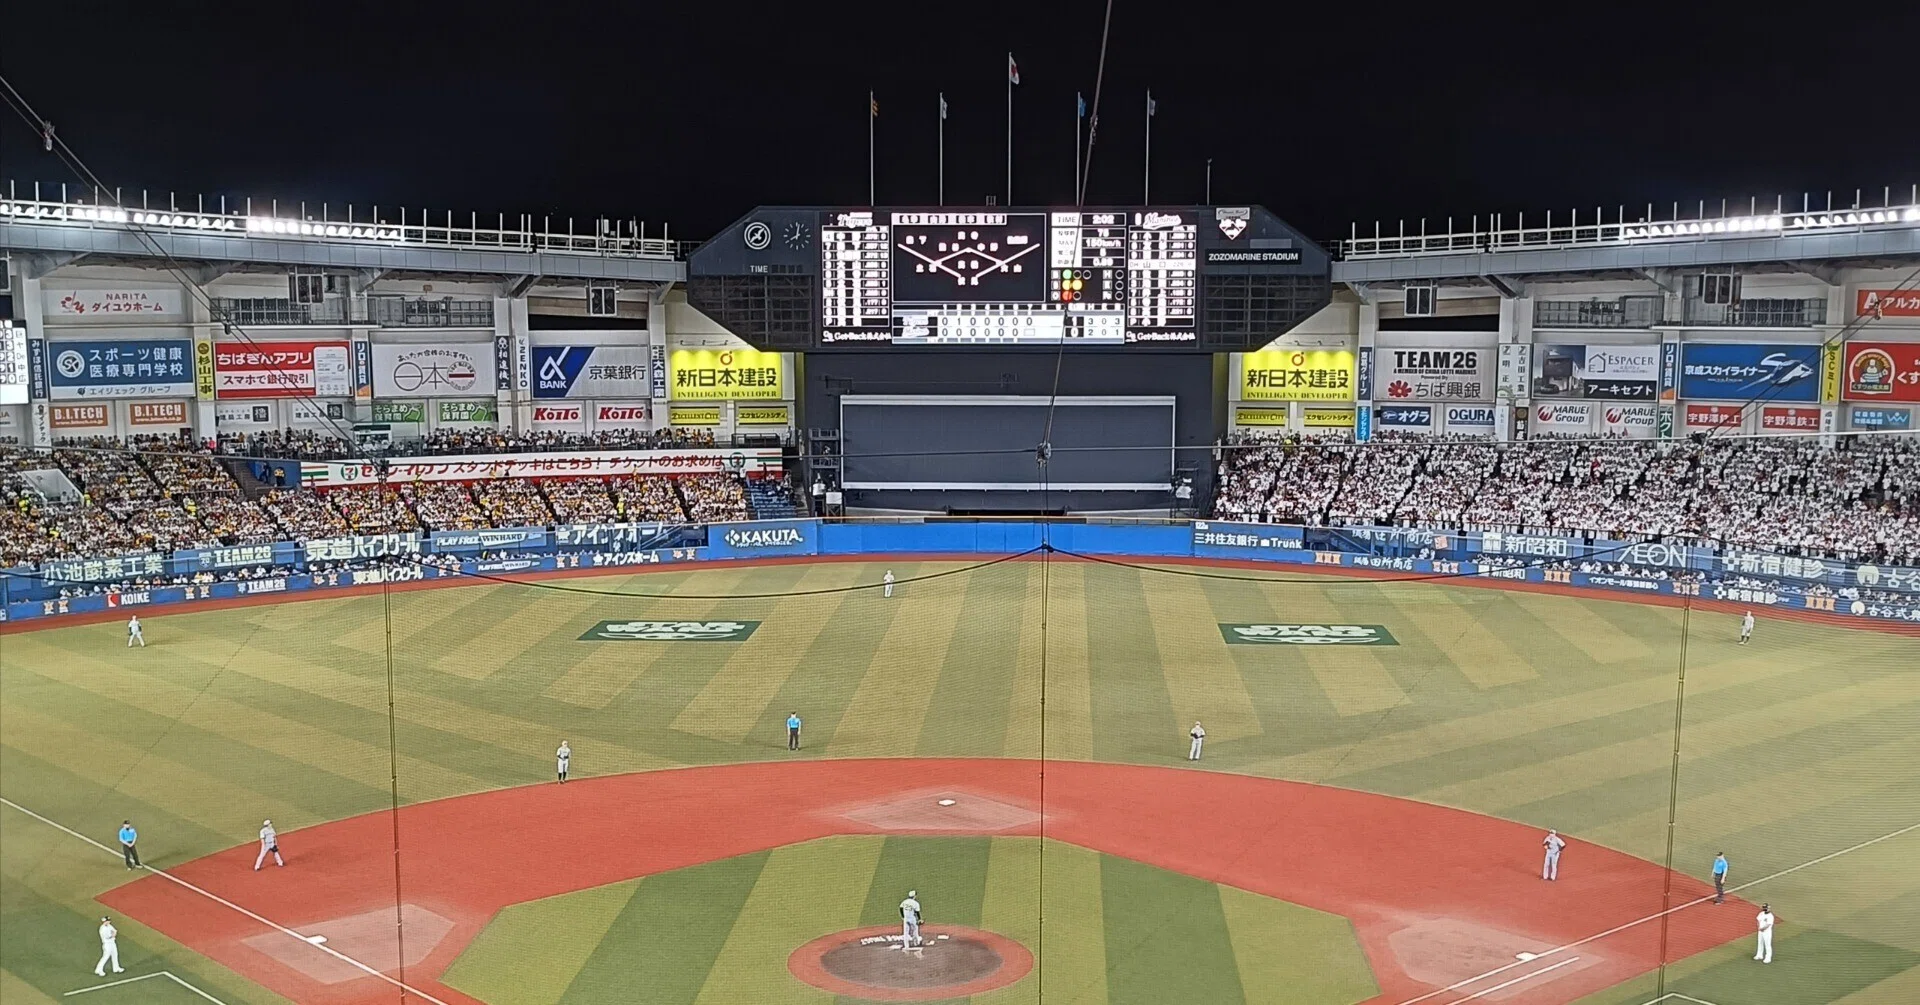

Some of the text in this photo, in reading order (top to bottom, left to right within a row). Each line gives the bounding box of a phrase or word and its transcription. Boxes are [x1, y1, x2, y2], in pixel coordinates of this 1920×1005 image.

[1208, 252, 1298, 261] ZOZOMARINE STADIUM
[750, 265, 768, 273] TIME
[106, 293, 147, 301] NARITA
[92, 302, 163, 313] ダイユウホーム
[942, 317, 948, 325] 0
[956, 317, 962, 325] 1
[970, 317, 976, 325] 0
[984, 317, 990, 325] 0
[998, 317, 1004, 325] 0
[1012, 317, 1018, 325] 0
[1026, 317, 1032, 325] 0
[1088, 317, 1094, 325] 3
[1101, 317, 1107, 325] 0
[1114, 317, 1120, 325] 3
[942, 329, 948, 337] 0
[956, 329, 962, 337] 0
[970, 329, 976, 337] 0
[984, 329, 990, 337] 0
[998, 329, 1004, 337] 0
[1012, 329, 1018, 337] 0
[1088, 329, 1094, 337] 2
[1101, 329, 1107, 337] 0
[1114, 329, 1120, 337] 1
[89, 348, 182, 363] スポーツ健康
[218, 352, 312, 366] ちばぎんアプリ
[1608, 355, 1654, 365] ESPACER
[32, 340, 44, 398] みずほ信託銀行
[89, 363, 184, 379] 医療専門学校
[519, 346, 528, 388] ZENKO
[588, 364, 645, 380] 京葉銀行
[1664, 344, 1675, 388] リロの賃貸
[1684, 365, 1768, 376] 京成スカイライナー
[198, 355, 213, 395] 杉山工事
[223, 372, 309, 386] スマホで銀行取引
[676, 368, 776, 387] 新日本建設
[1246, 368, 1349, 388] 新日本建設
[89, 384, 171, 397] エイジェック グループ
[539, 380, 566, 389] BANK
[1414, 382, 1480, 398] ちば興銀
[1588, 384, 1653, 396] アーキセプト
[54, 407, 103, 420] B.I.TECH
[134, 404, 182, 417] B.I.TECH
[373, 404, 408, 413] そらまめ
[441, 402, 475, 412] そらまめ
[1553, 405, 1590, 415] MARUEI
[373, 413, 404, 422] 保育園
[442, 412, 473, 421] 保育園
[740, 412, 786, 420] エクセレントシティ
[1306, 413, 1353, 421] エクセレントシティ
[1398, 410, 1430, 423] オグラ
[1449, 409, 1494, 421] OGURA
[1555, 413, 1585, 424] Group
[1624, 416, 1654, 426] Group
[482, 532, 523, 543] WINHARD
[741, 529, 799, 543] KAKUTA
[1194, 533, 1302, 549] 三井住友銀行 Trunk
[306, 532, 421, 562] 東進ハイスクール
[1505, 535, 1567, 557] 新昭和
[603, 551, 660, 566] アインズホーム
[1370, 557, 1413, 571] 田所商店
[44, 554, 164, 585] 小池酸素工業
[1491, 566, 1526, 580] 新昭和
[1740, 554, 1825, 579] 新宿健診
[352, 566, 424, 585] 東進ハイスクール
[121, 592, 150, 605] KOIKE
[1727, 588, 1777, 604] 新宿健診
